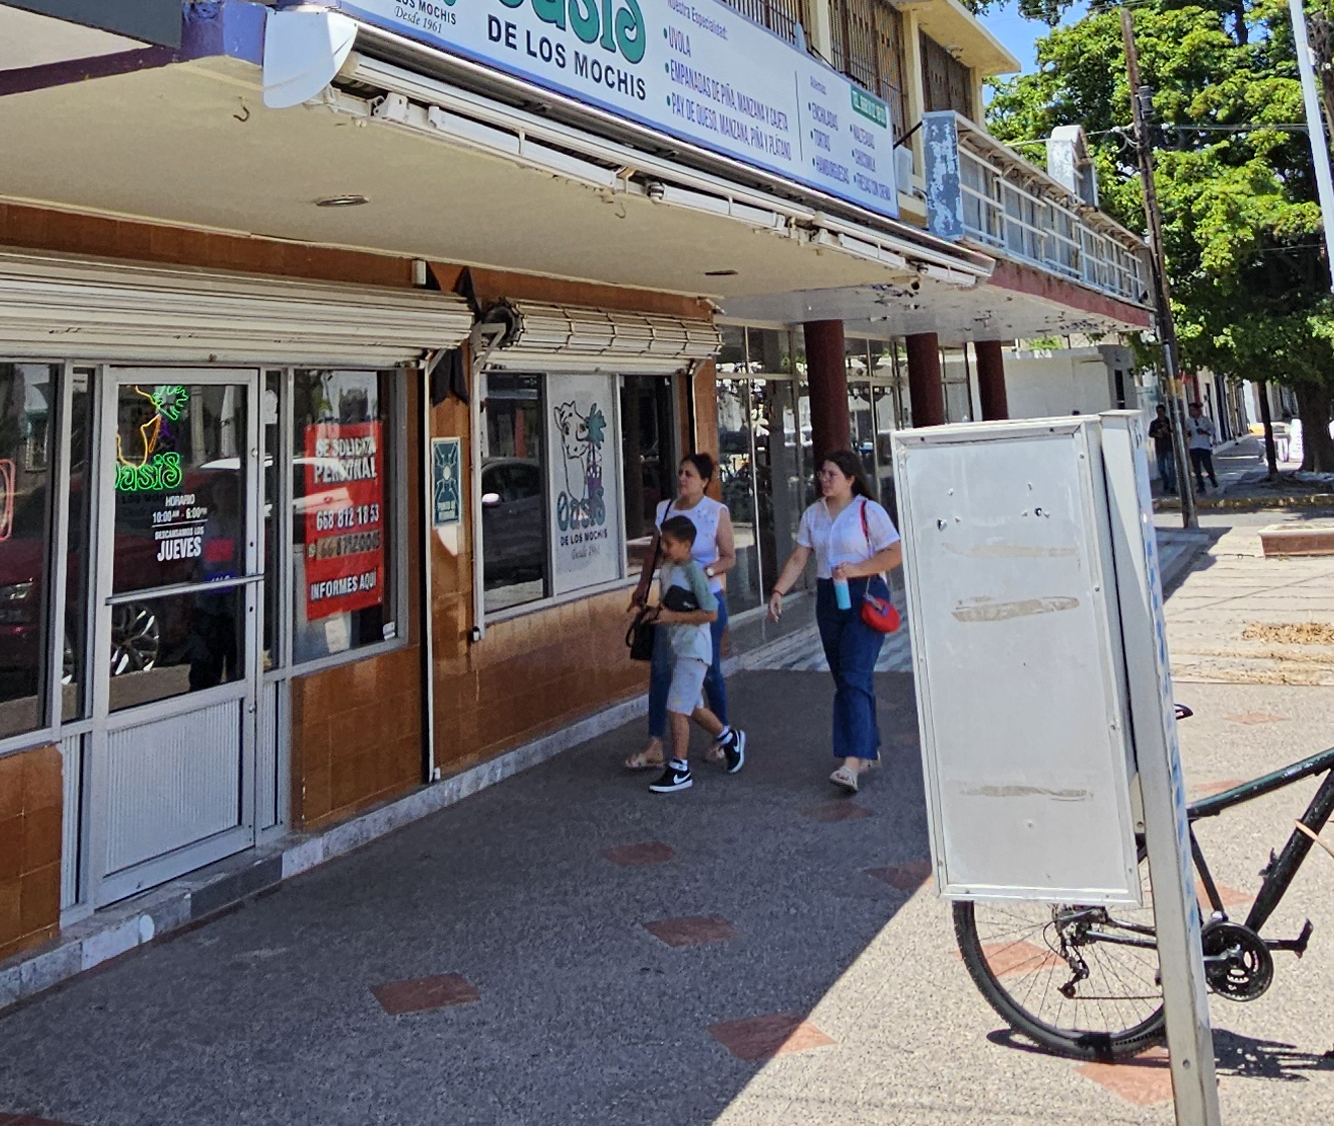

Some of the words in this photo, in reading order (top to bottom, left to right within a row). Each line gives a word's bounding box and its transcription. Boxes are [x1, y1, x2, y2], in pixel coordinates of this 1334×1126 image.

[394, 5, 421, 27] Desde
[422, 16, 443, 35] 1961
[418, 0, 457, 25] MOCHIS
[668, 25, 691, 58] UVOLA
[487, 14, 517, 50] DE
[525, 29, 567, 68] LOS
[574, 50, 647, 101] MOCHIS
[670, 59, 711, 98] EMPANADAS
[711, 79, 720, 103] DE
[737, 91, 765, 122] MANZANA
[770, 107, 789, 132] CAJETA
[672, 92, 684, 118] PAY
[686, 98, 696, 123] DE
[750, 126, 764, 150] PIÑA
[316, 438, 330, 458] SE
[332, 435, 377, 457] SOLICITA
[313, 455, 377, 485] PERSONAL
[165, 494, 195, 507] HORARIO
[316, 509, 334, 531] 668
[337, 507, 355, 529] 812
[369, 503, 380, 523] 53
[157, 536, 202, 562] JUEVES
[560, 535, 569, 546] DE
[570, 533, 583, 545] LOS
[584, 529, 608, 541] MOCHIS
[310, 574, 358, 602] INFORMES
